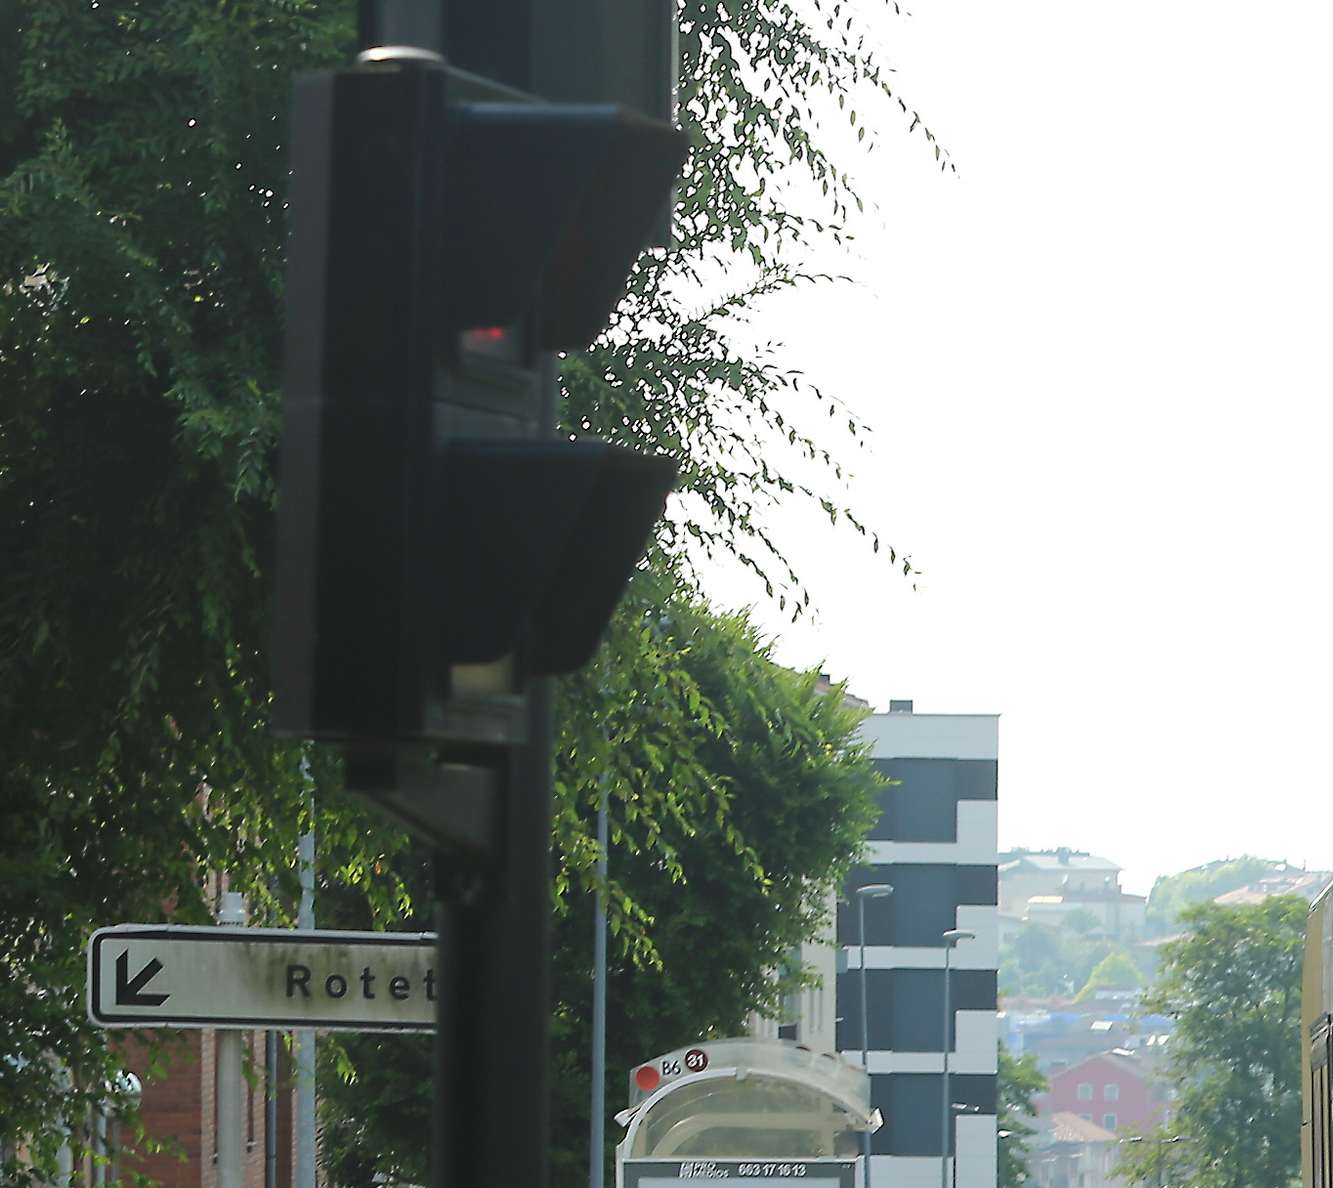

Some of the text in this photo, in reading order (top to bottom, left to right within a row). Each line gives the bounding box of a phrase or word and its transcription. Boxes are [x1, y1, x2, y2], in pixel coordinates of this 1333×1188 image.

[286, 964, 437, 1001] Rotet
[662, 1054, 704, 1075] B6 31
